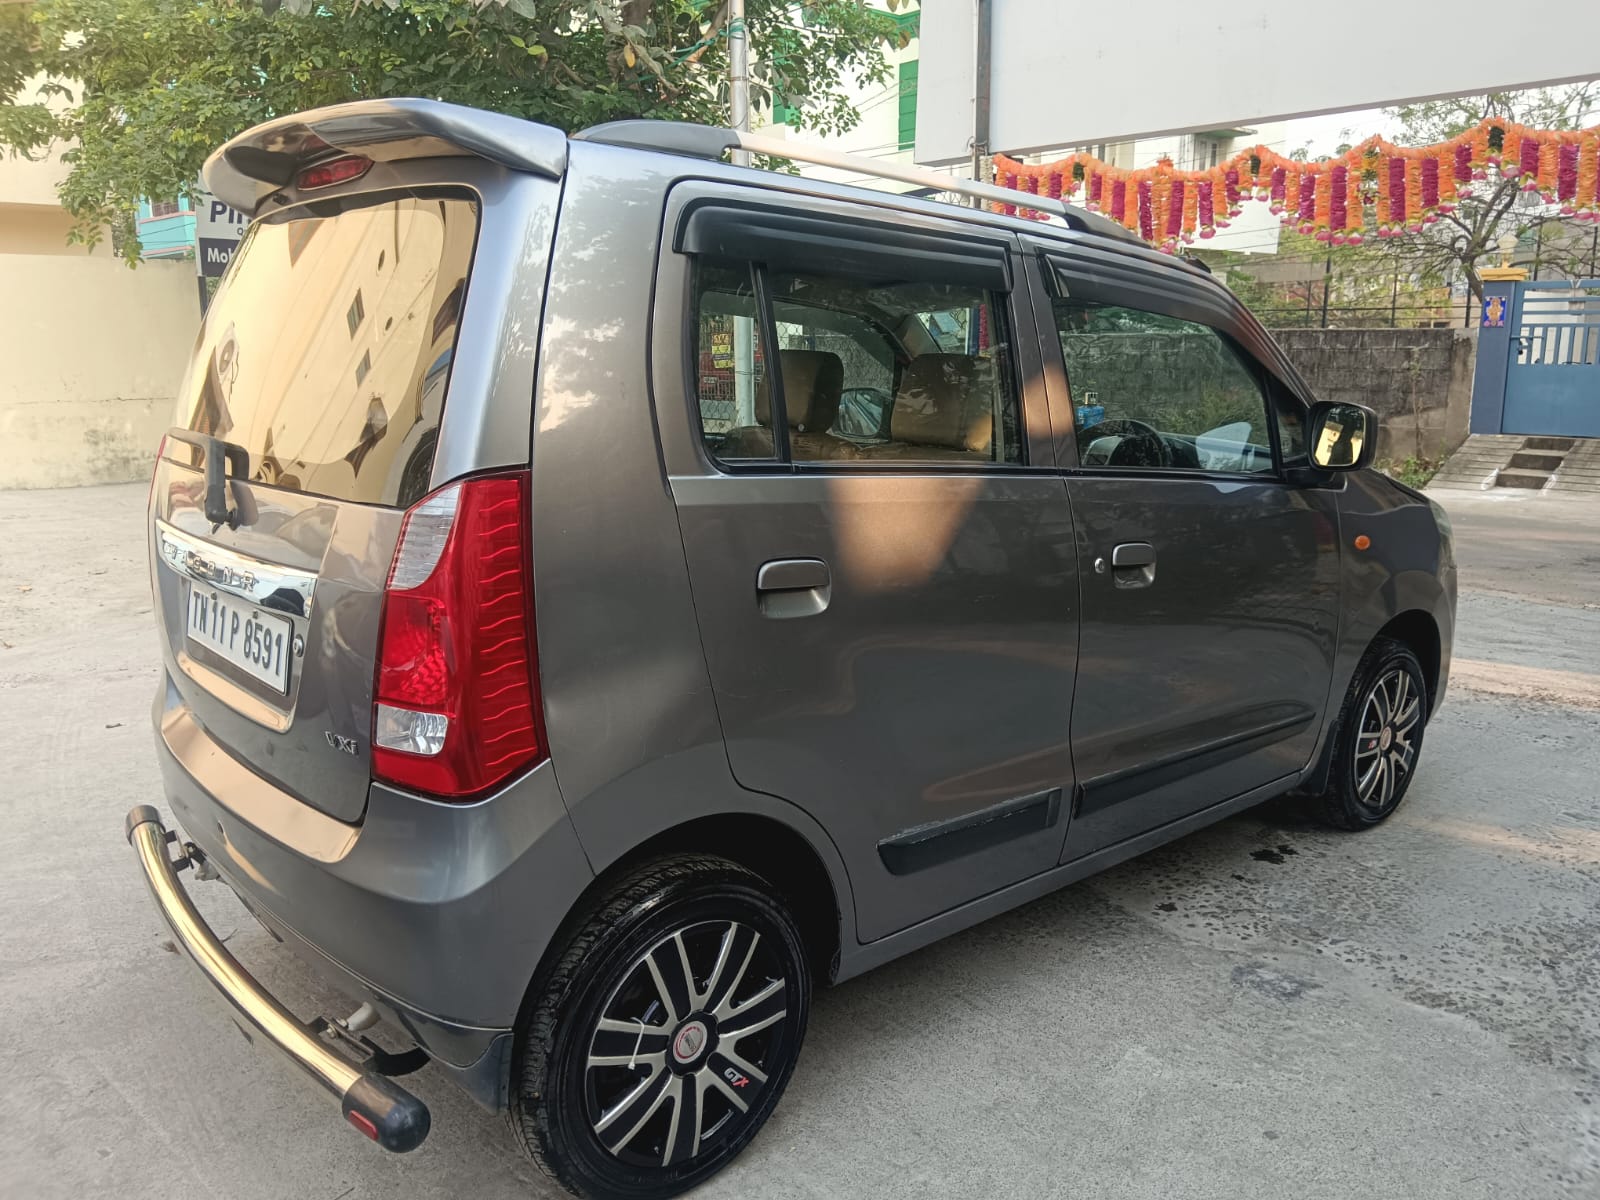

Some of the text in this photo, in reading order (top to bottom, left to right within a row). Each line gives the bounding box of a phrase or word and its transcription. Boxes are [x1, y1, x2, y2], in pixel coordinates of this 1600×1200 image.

[193, 590, 282, 676] TN 11 P 8591
